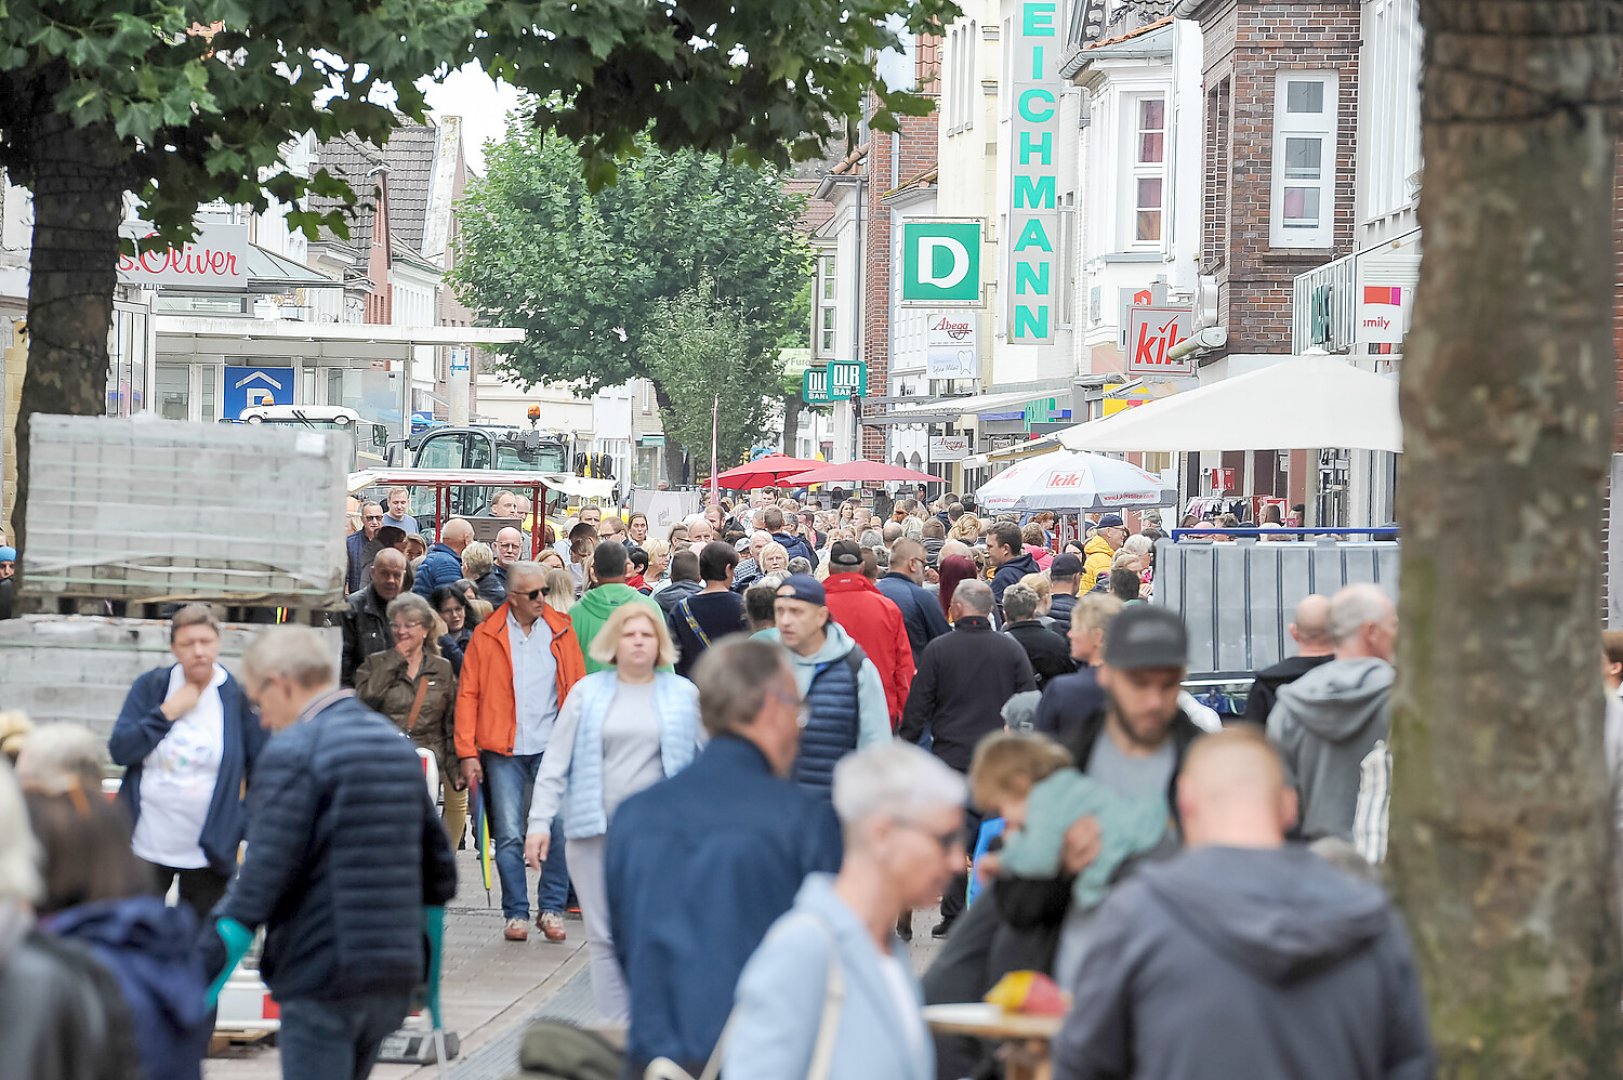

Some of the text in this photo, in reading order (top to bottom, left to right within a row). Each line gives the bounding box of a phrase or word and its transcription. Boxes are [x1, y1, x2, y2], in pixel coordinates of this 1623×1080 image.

[1013, 2, 1056, 339] EICHMANN
[917, 235, 970, 289] D
[1134, 314, 1189, 366] kik
[833, 364, 860, 386] OLB
[1050, 473, 1081, 487] kik
